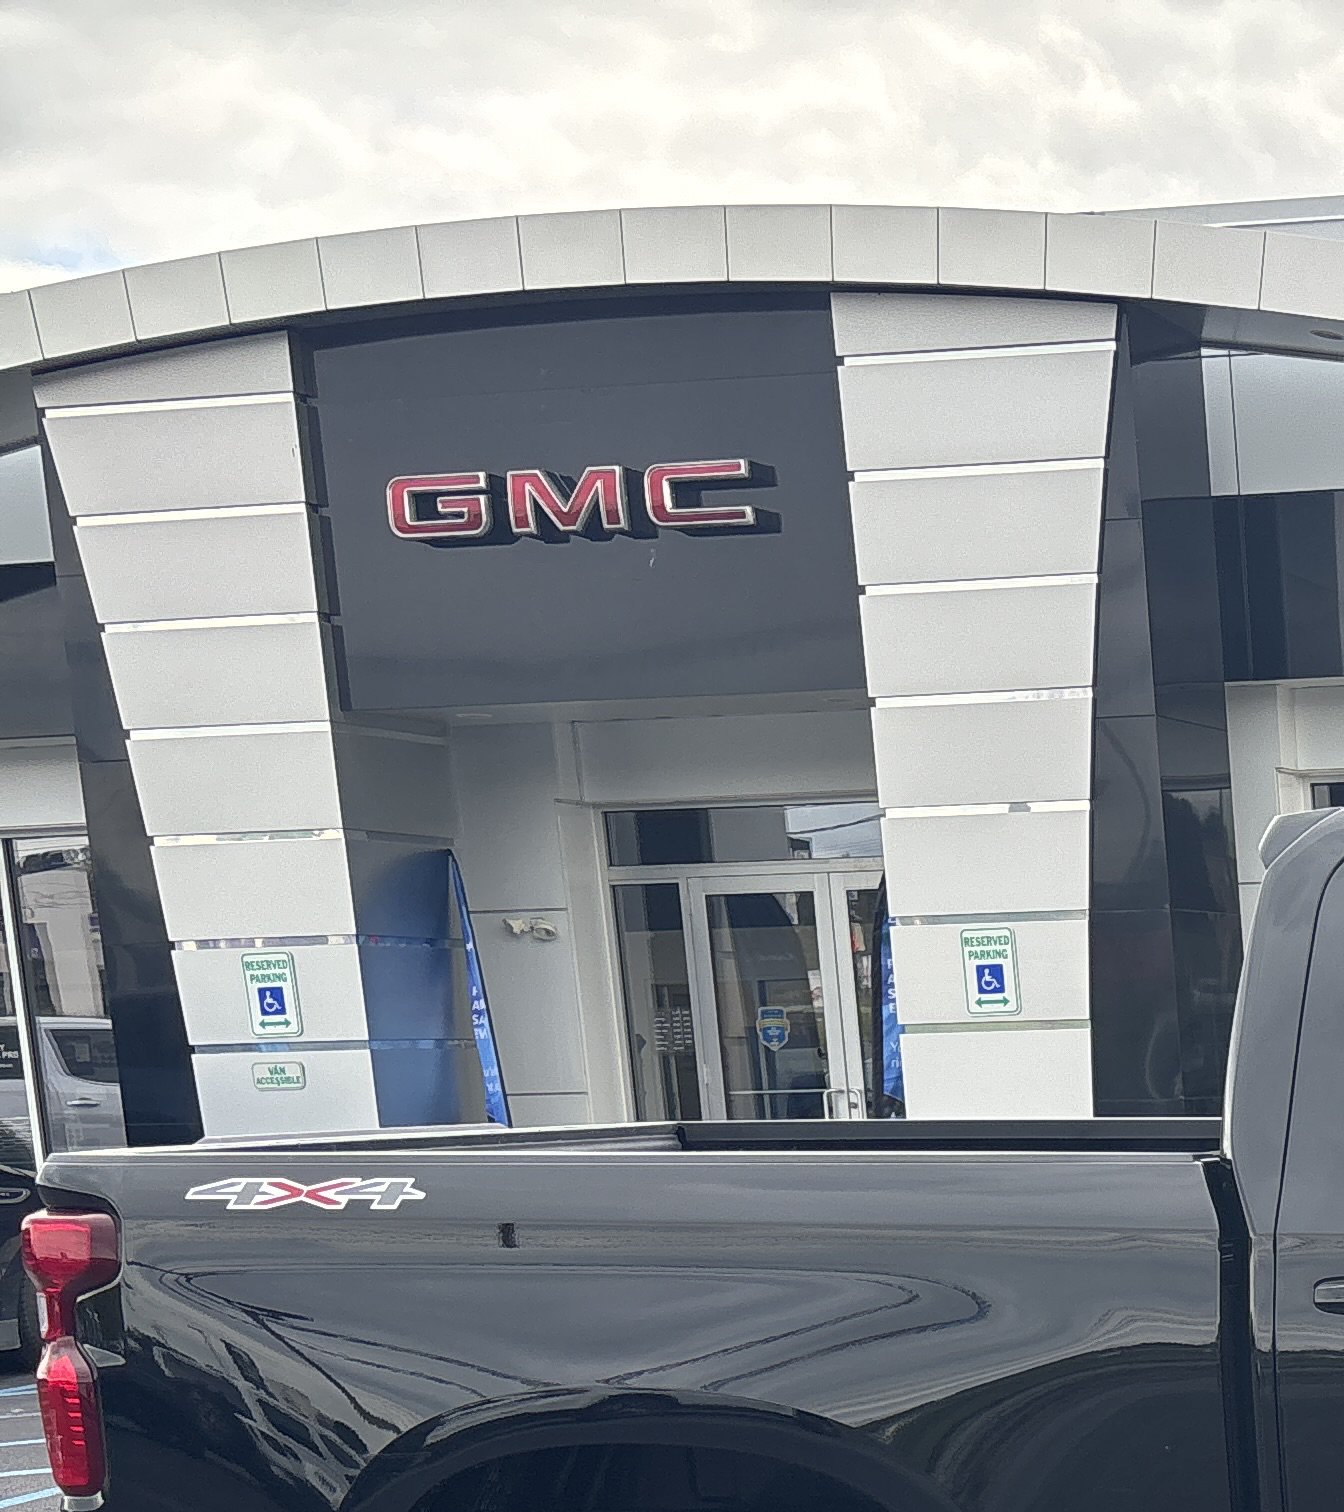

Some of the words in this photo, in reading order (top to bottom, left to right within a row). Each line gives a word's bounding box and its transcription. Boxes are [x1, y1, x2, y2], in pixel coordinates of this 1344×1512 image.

[386, 458, 757, 539] GMC
[963, 935, 1009, 947] RESERVED
[967, 949, 1009, 961] PARKING
[244, 959, 288, 972] RESERVED
[249, 972, 288, 984] PARKING
[267, 1065, 287, 1076] VAN
[256, 1075, 301, 1086] ACCESSIBLE
